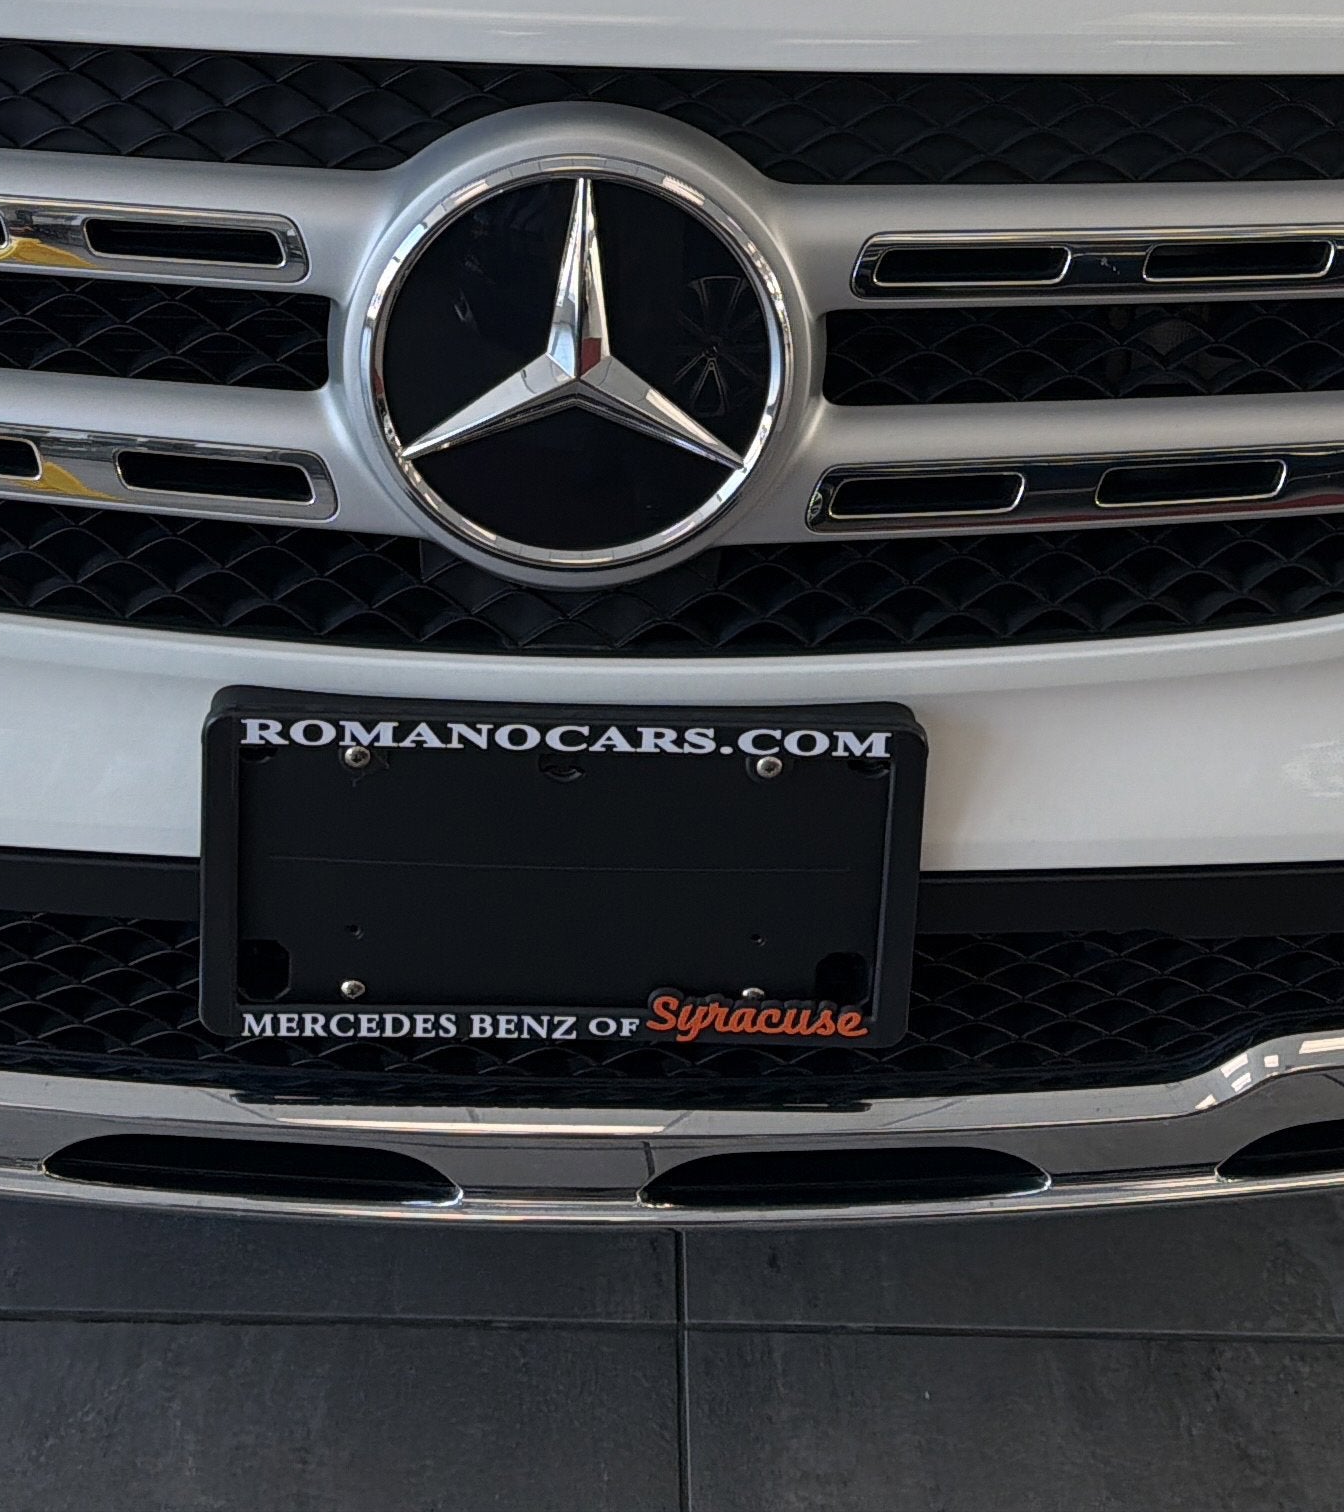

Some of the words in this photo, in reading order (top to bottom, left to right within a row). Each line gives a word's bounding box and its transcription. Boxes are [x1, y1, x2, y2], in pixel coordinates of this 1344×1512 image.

[240, 718, 892, 758] ROMANOCARS.COM
[241, 1013, 457, 1038] MERCEDES
[469, 1014, 577, 1040] BENZ
[588, 1017, 640, 1037] OF
[646, 995, 869, 1042] Syracuse
